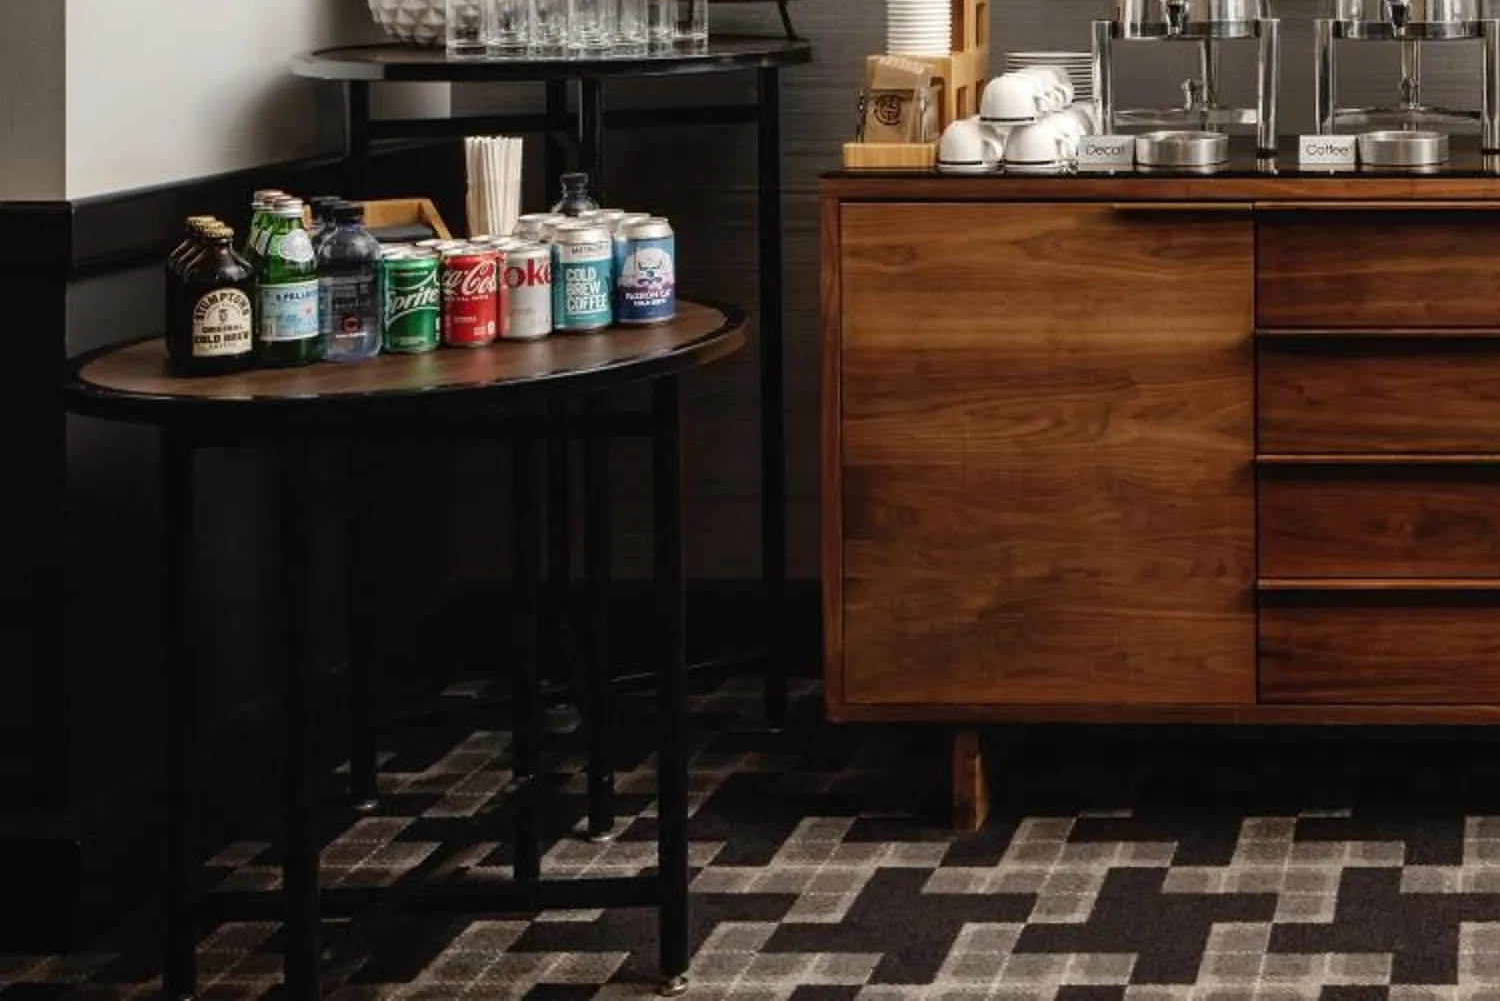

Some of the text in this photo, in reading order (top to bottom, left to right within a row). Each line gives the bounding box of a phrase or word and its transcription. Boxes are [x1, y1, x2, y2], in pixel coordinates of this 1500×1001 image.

[1305, 142, 1349, 156] Coffee
[565, 266, 597, 282] COLD
[565, 280, 602, 297] BREW
[566, 293, 608, 315] COFFEE
[194, 331, 249, 344] COLD BREW
